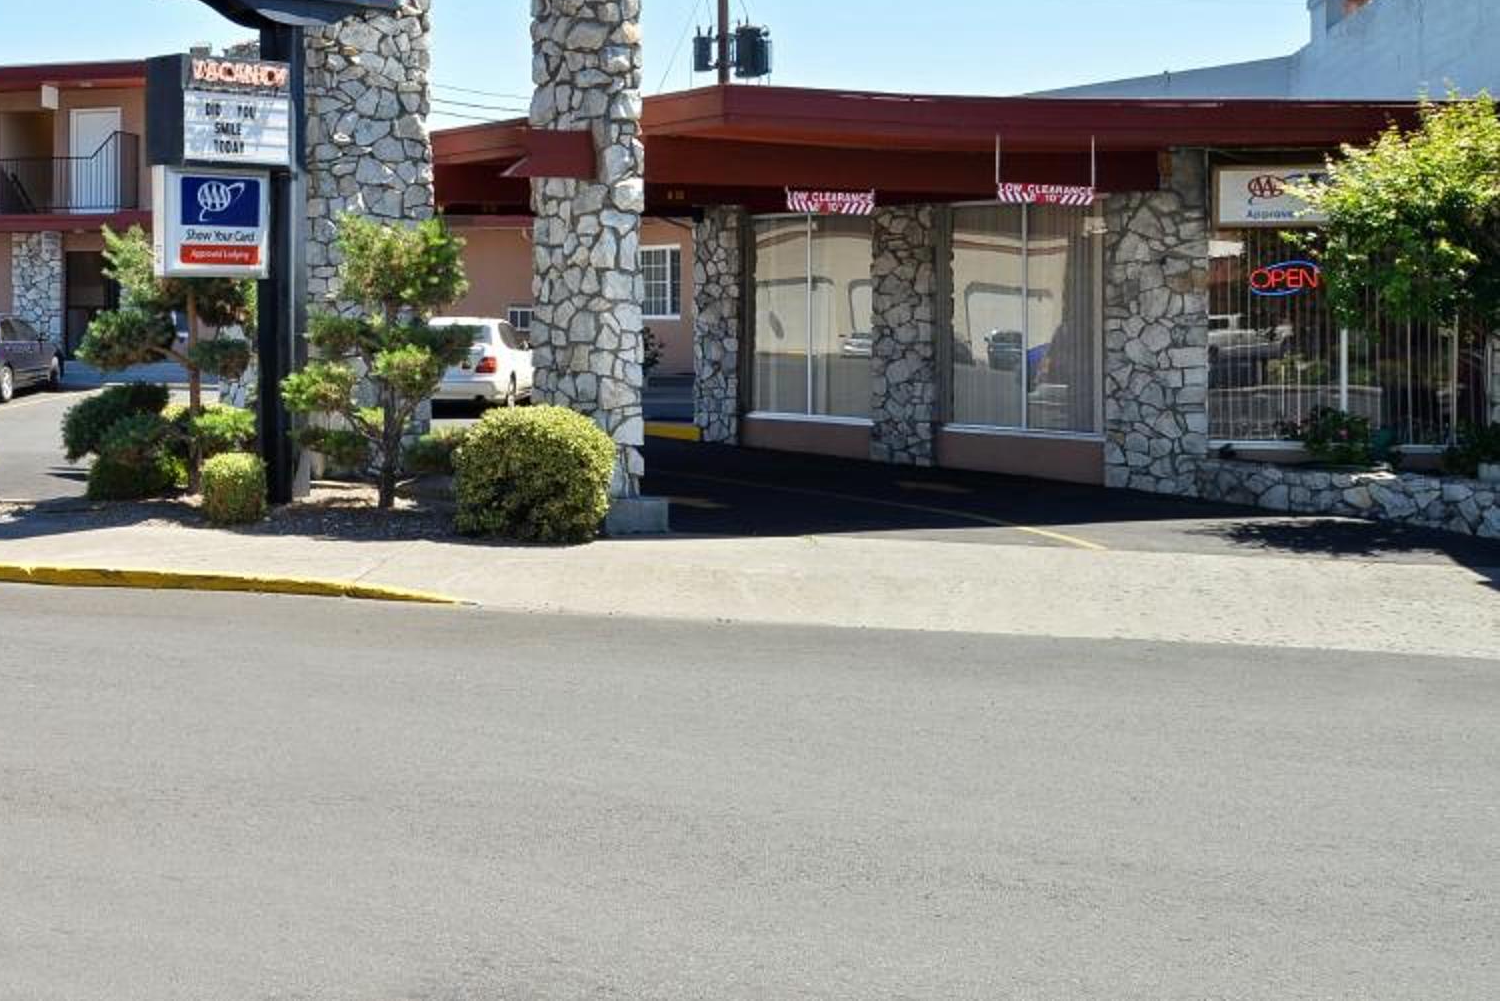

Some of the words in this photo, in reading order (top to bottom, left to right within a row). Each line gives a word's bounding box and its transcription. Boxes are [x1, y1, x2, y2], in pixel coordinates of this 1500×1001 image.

[206, 103, 221, 116] DID
[236, 105, 257, 119] YOU
[214, 122, 241, 135] SMILE
[213, 139, 244, 154] TODAY
[999, 183, 1022, 192] LOW
[1028, 185, 1093, 196] CLEARANCE
[787, 191, 808, 201] LOW
[812, 192, 874, 203] CLEARANCE
[186, 229, 211, 241] Show
[213, 230, 233, 242] Your
[235, 231, 255, 241] Card
[1251, 268, 1317, 288] OPEN
